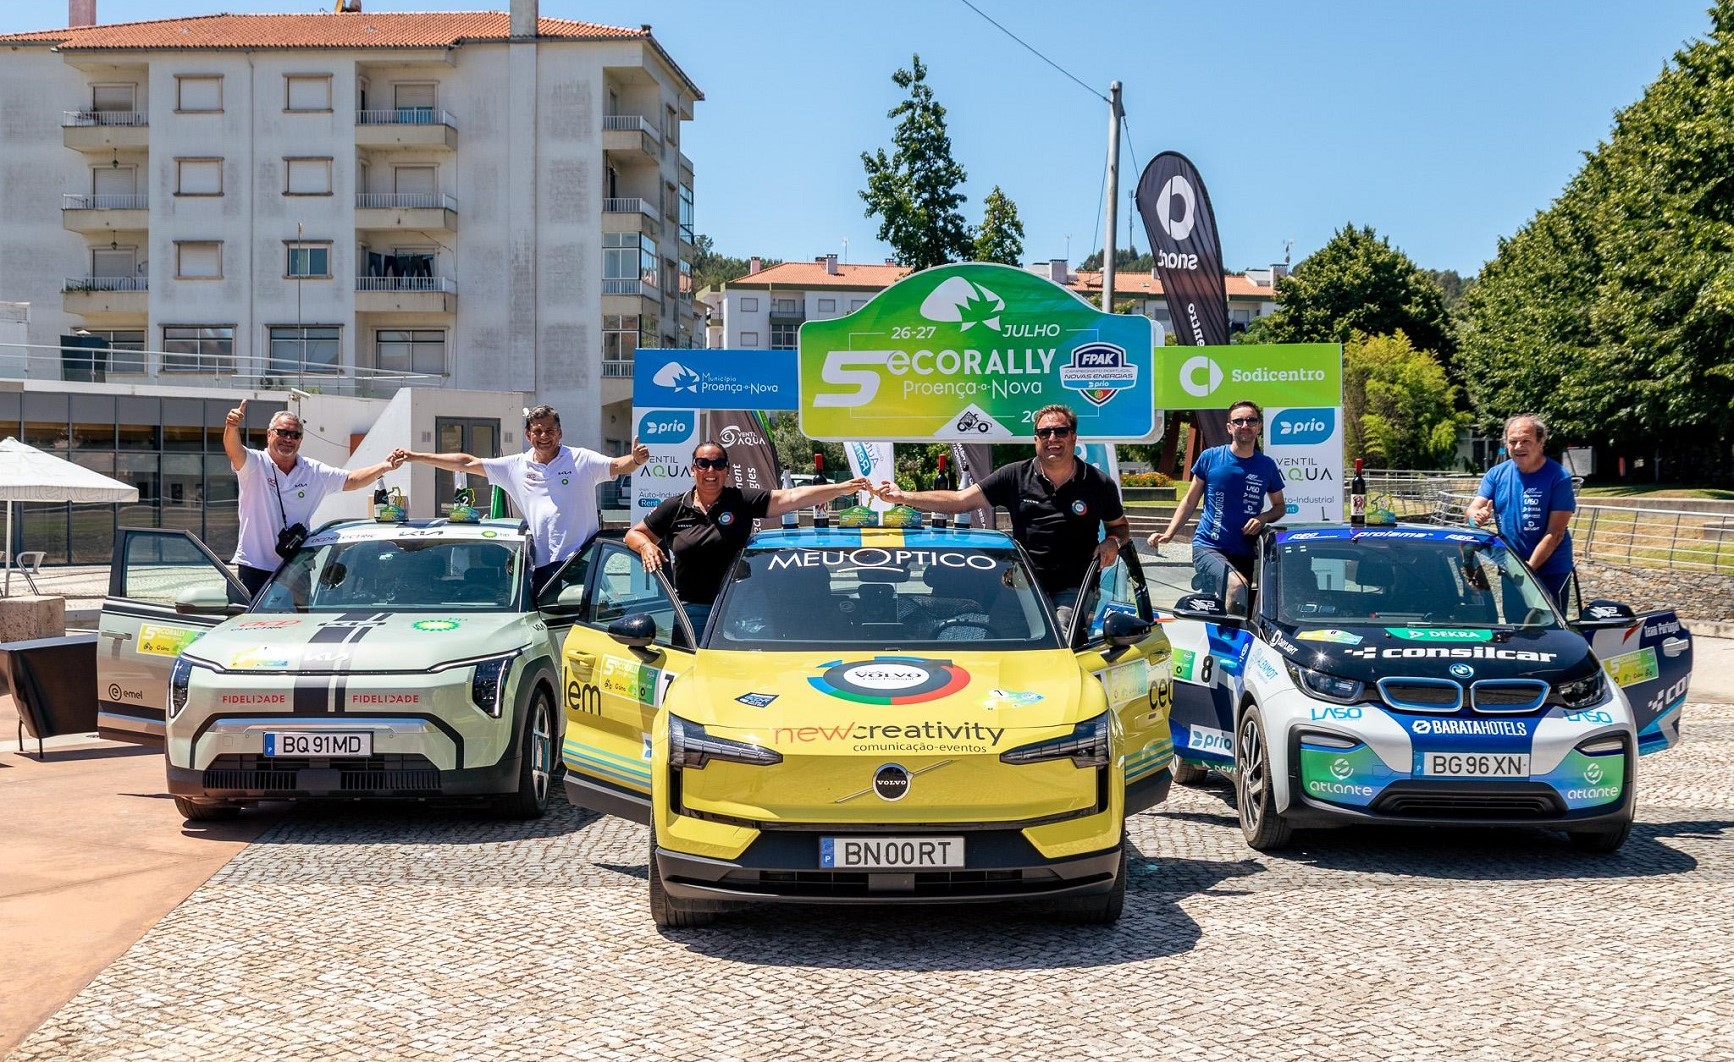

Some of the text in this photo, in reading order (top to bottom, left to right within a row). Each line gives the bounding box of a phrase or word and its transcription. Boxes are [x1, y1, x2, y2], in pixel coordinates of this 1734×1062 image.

[891, 324, 1061, 339] 26-27 JULHO
[1081, 353, 1116, 365] FPAK
[1232, 367, 1325, 382] Sodicentro
[903, 379, 1042, 400] Proença-a-Nova
[1094, 380, 1110, 388] prio
[658, 419, 686, 434] prio
[1293, 418, 1325, 434] prio
[1429, 630, 1481, 639] DEKRA
[1382, 646, 1557, 662] consilcar
[1201, 655, 1214, 683] 8
[123, 690, 143, 700] emel
[222, 695, 285, 704] FIDELIDADE
[352, 694, 420, 704] FIDELIDADE
[1311, 707, 1363, 721] LASO
[1432, 720, 1528, 736] BARATAHOTELS
[283, 736, 361, 753] BQ 91 MD
[853, 741, 987, 753] comunicação-eventos
[1203, 732, 1232, 750] prio
[1433, 755, 1522, 775] BG 96 XN
[1309, 781, 1373, 796] atlante
[1567, 786, 1619, 799] atlante
[845, 842, 881, 866] BN
[919, 842, 951, 866] RT
